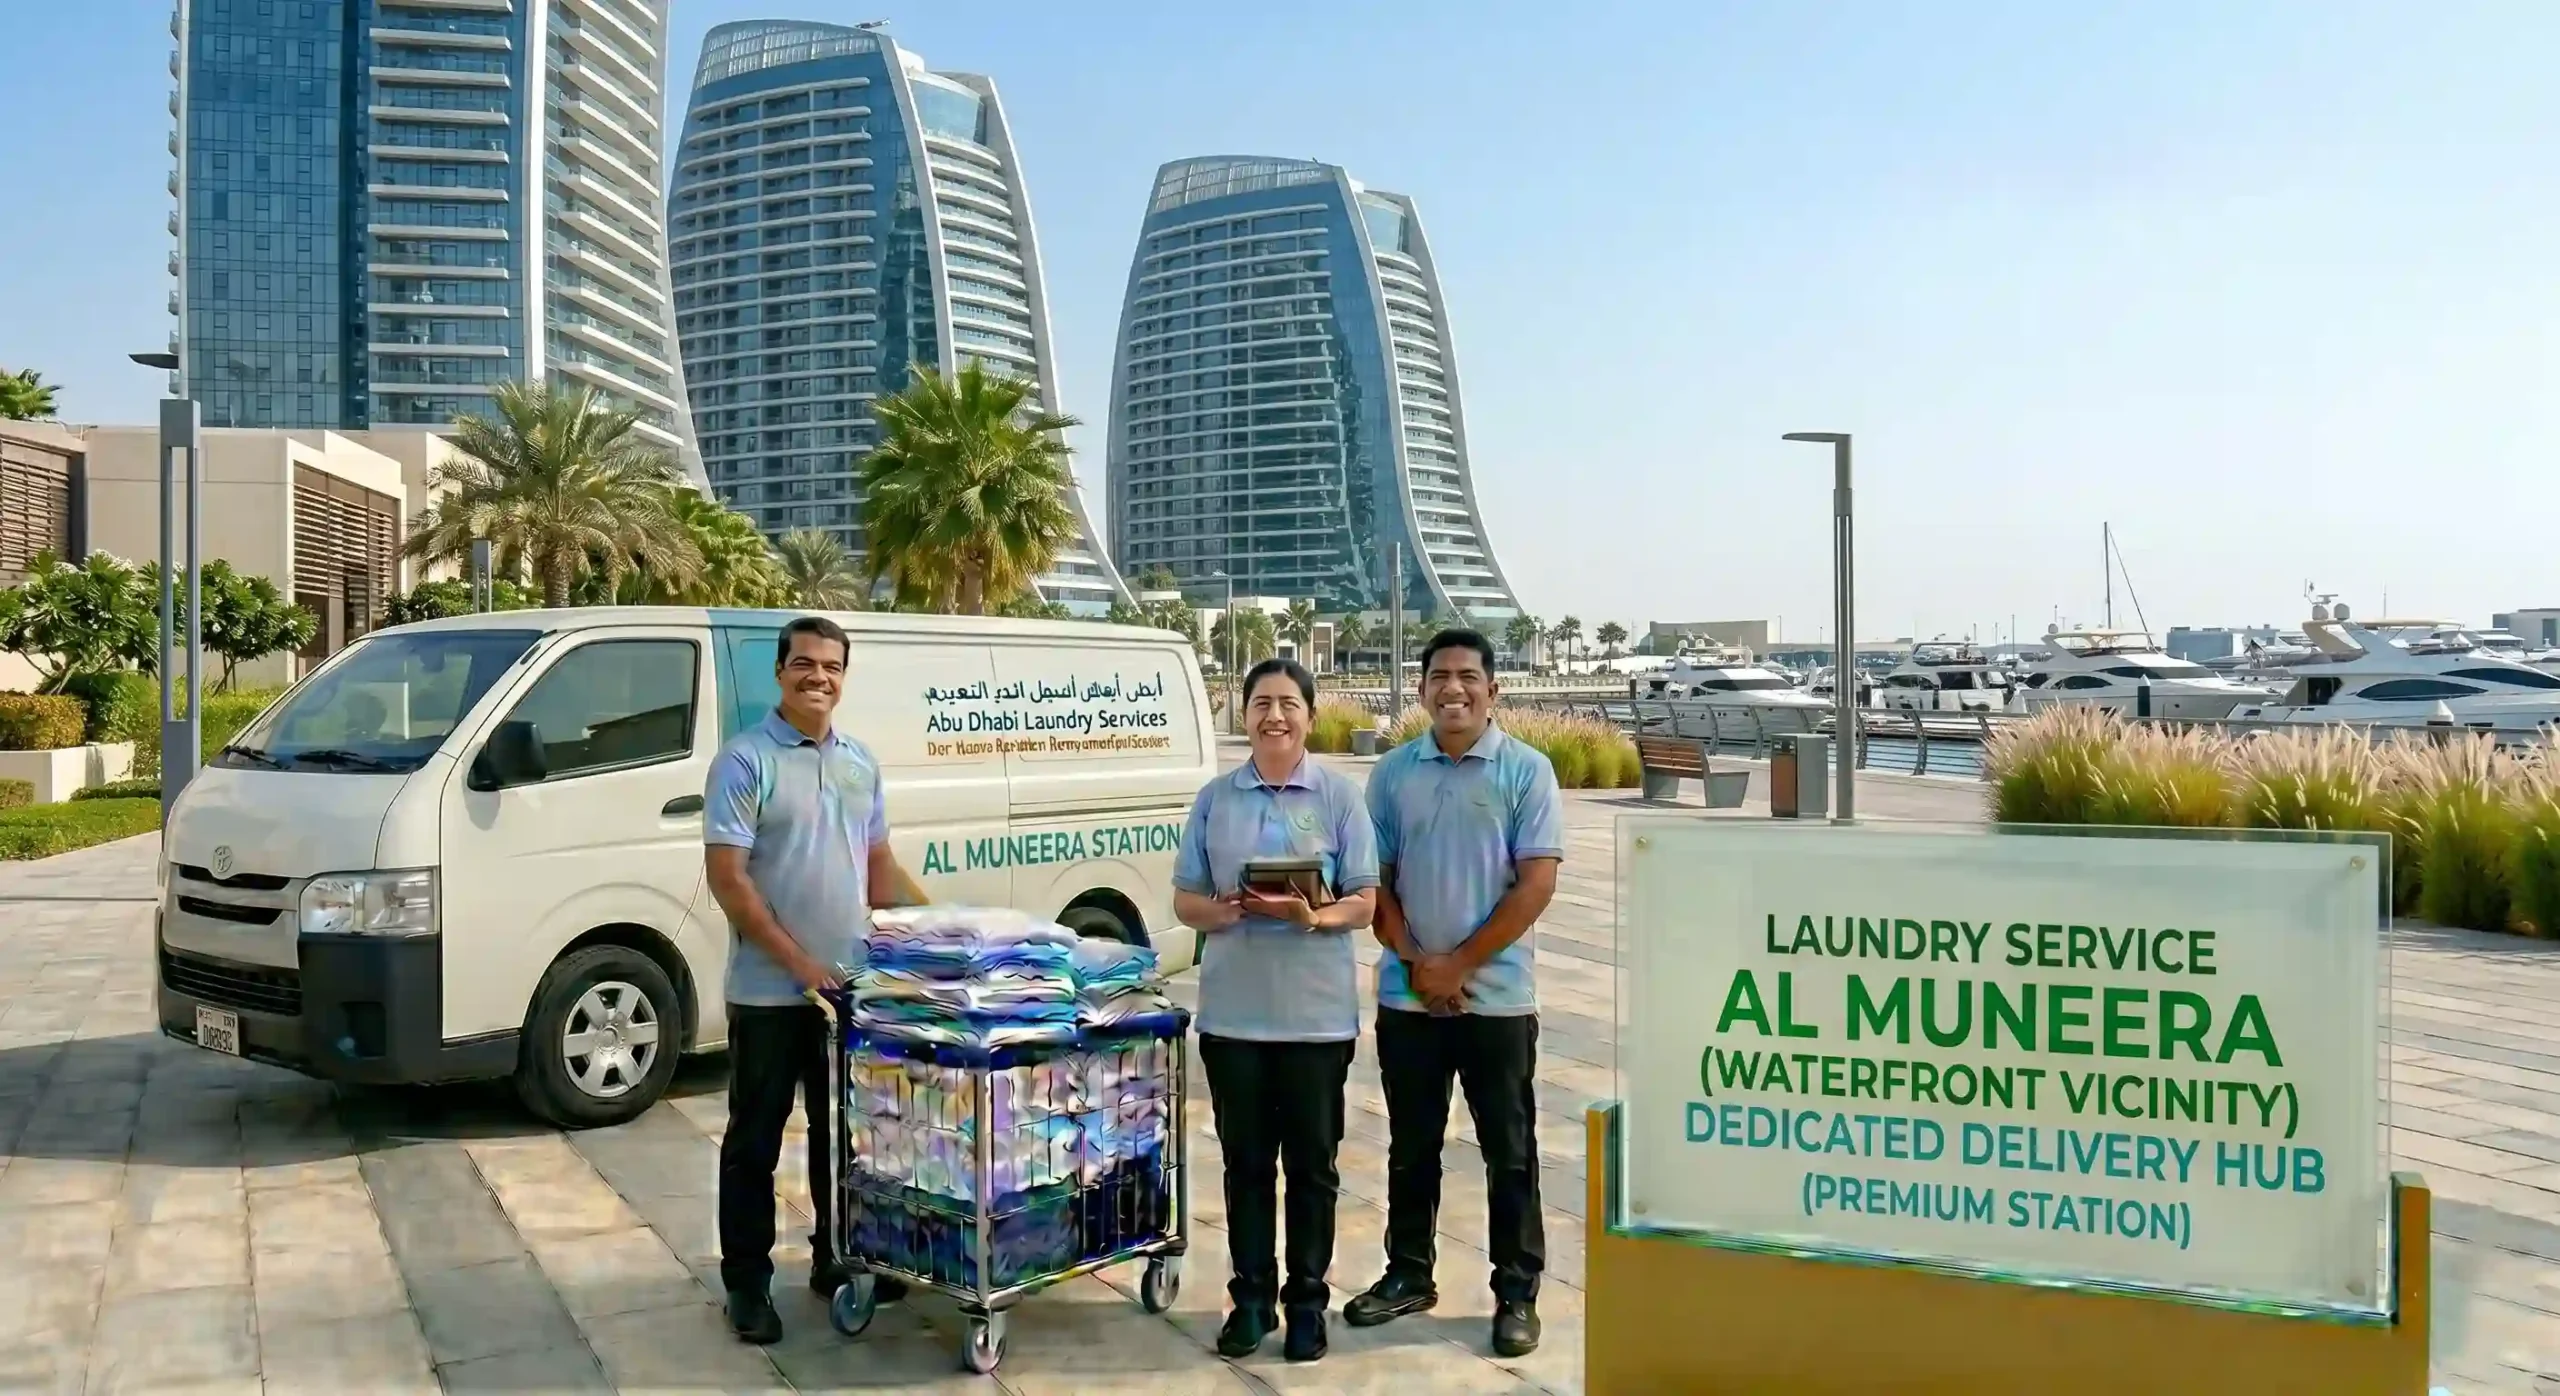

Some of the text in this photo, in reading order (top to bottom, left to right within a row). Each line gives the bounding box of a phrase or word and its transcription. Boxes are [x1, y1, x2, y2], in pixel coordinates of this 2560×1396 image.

[926, 709, 1167, 734] Abu Dhabi Laundry Services
[922, 822, 1181, 876] AL MUNEERA STATION
[1767, 914, 2217, 975] LAUNDRY SERVICE
[1715, 968, 2285, 1068] AL MUNEERA
[1700, 1045, 2299, 1139] (WATERFRONT VICINITY)
[1685, 1102, 2326, 1195] DEDICATED DELIVERY HUB
[1802, 1172, 2191, 1250] (PREMIUM STATION)
